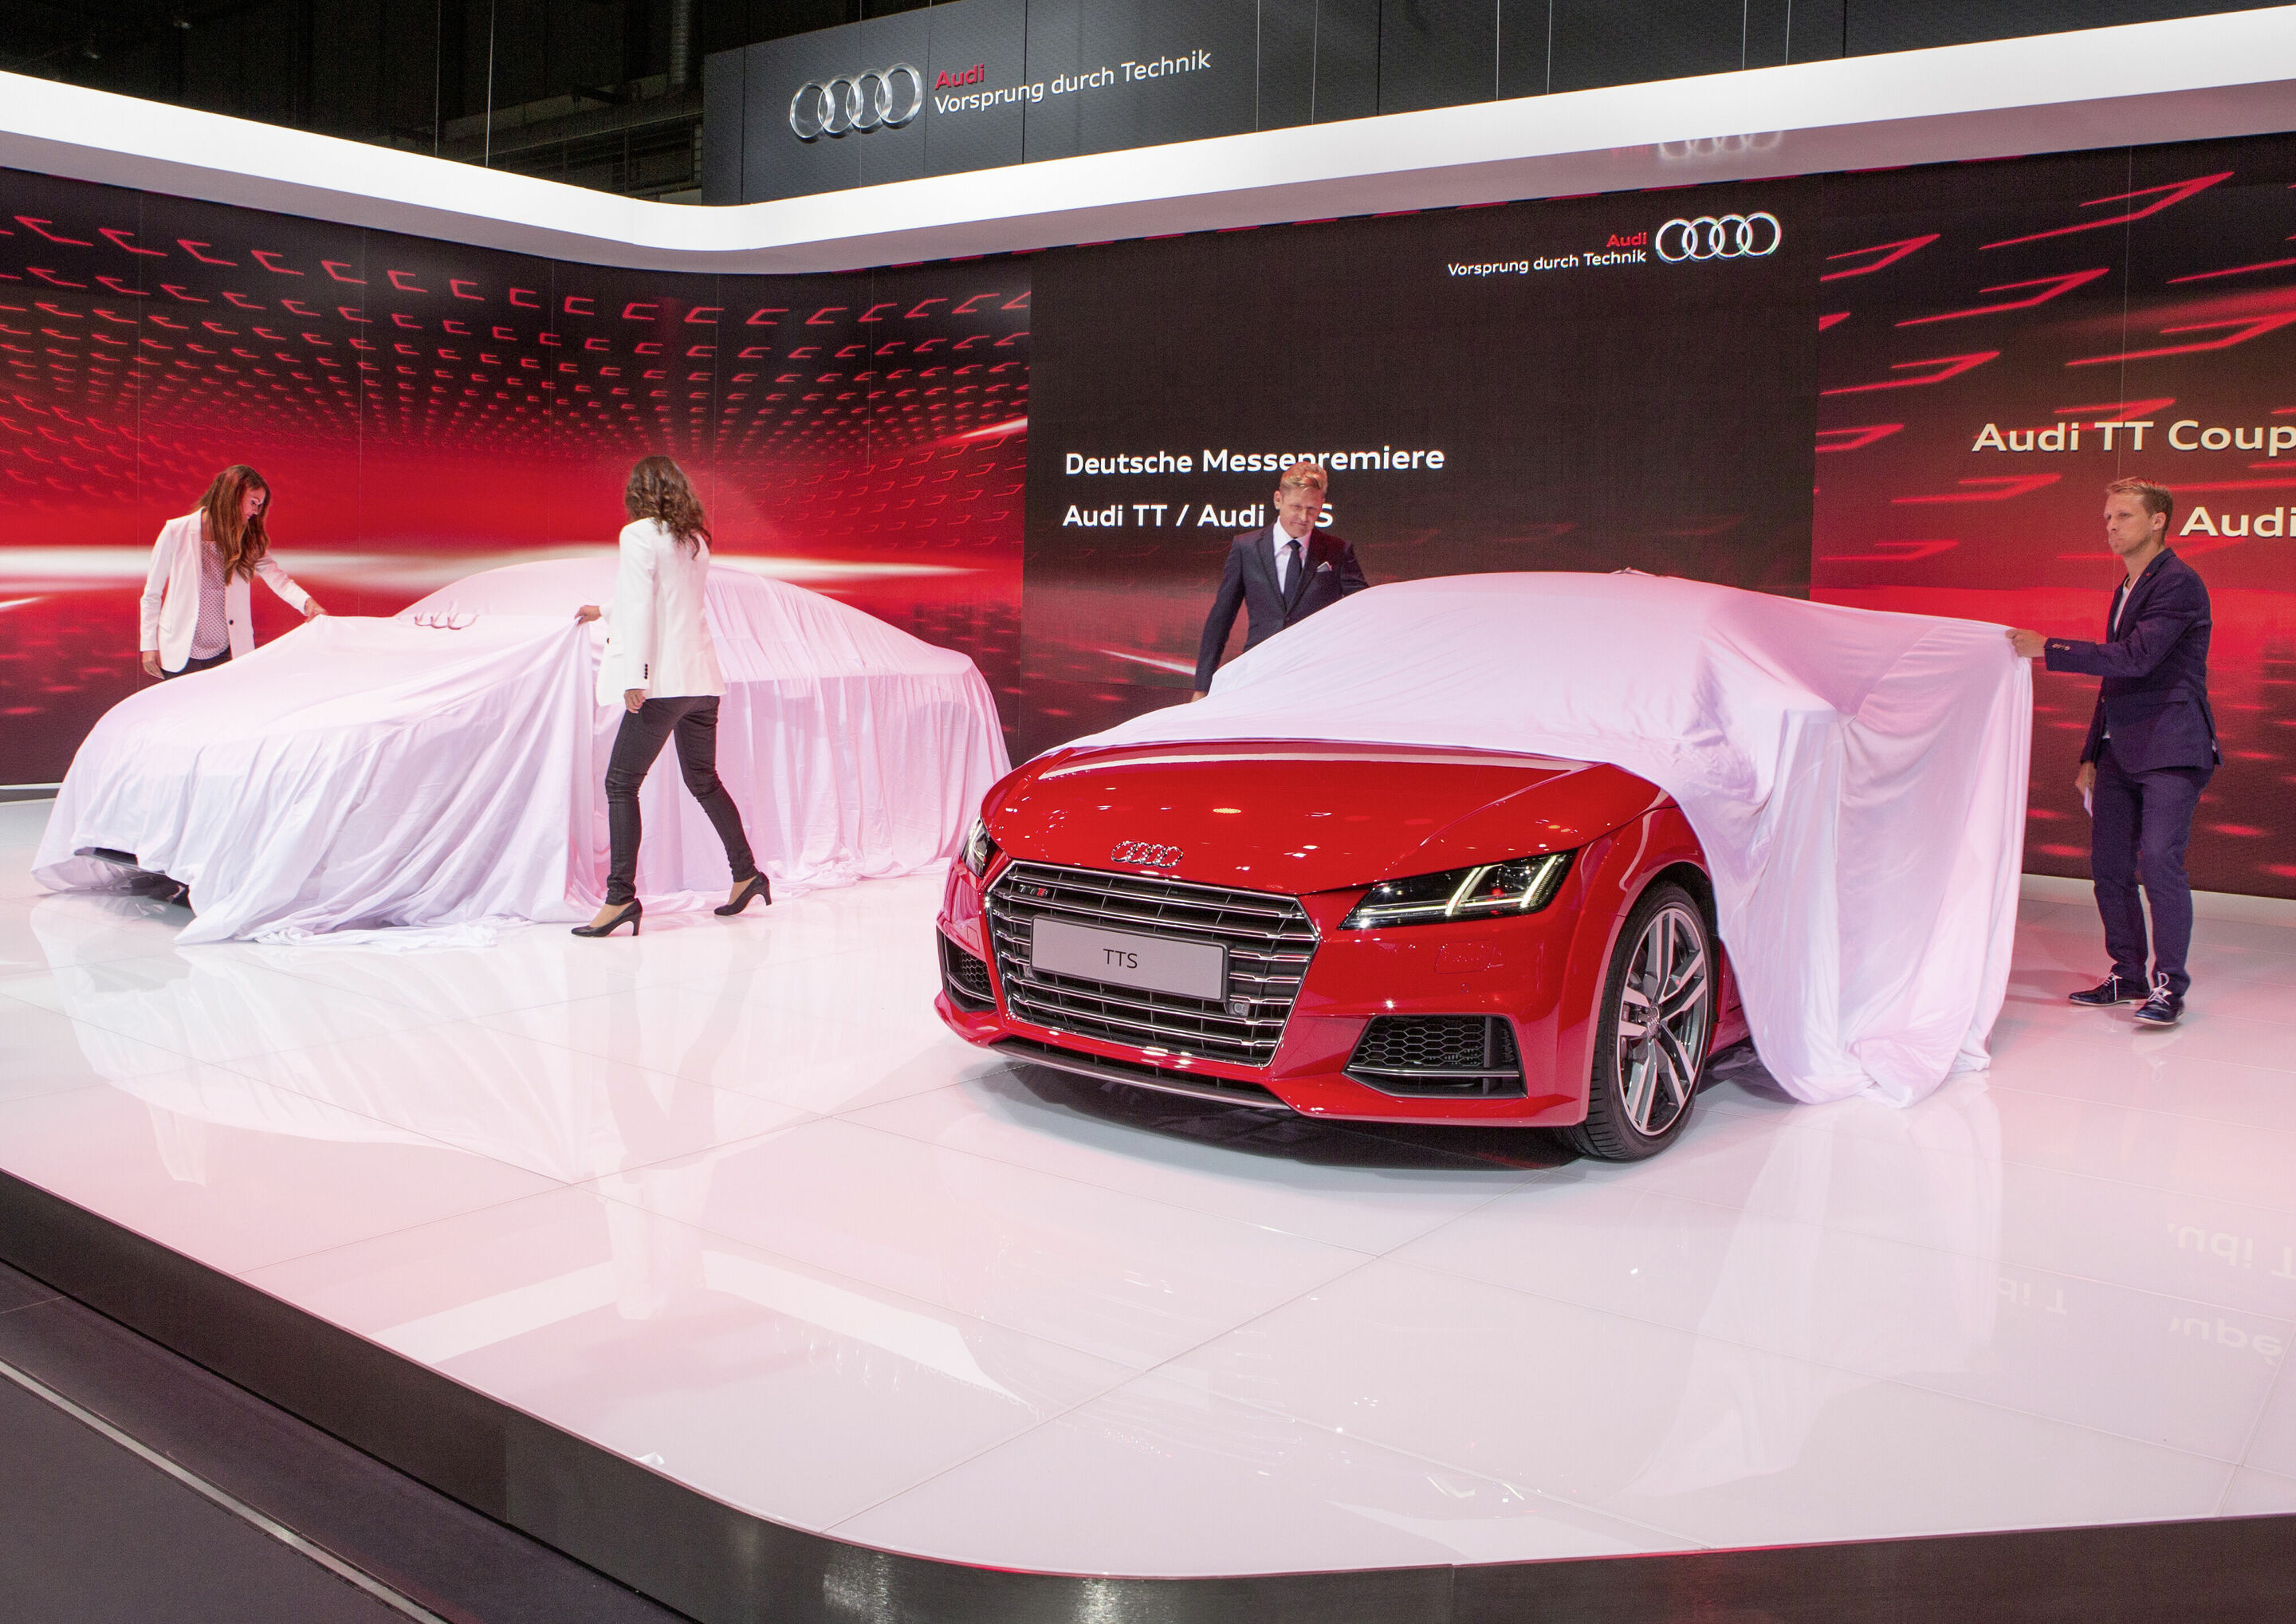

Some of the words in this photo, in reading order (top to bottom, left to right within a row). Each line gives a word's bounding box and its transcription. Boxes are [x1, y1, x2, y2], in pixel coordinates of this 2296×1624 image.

[934, 63, 985, 90] Audi
[934, 82, 1044, 115] Vorsprung
[1051, 66, 1115, 94] durch
[1120, 49, 1211, 82] Technik
[1606, 231, 1648, 248] Audi
[1448, 260, 1529, 277] Vorsprung
[1533, 254, 1578, 270] durch
[1583, 250, 1647, 267] Technik
[1972, 422, 2078, 451] Audi
[2094, 421, 2154, 450] TT
[2168, 419, 2296, 457] Coup
[1065, 450, 1193, 475] Deutsche
[1062, 504, 1123, 527] Audi
[1132, 504, 1168, 527] TT
[1197, 503, 1265, 527] Audi
[2179, 505, 2296, 537] Audi
[1103, 948, 1138, 969] TTS
